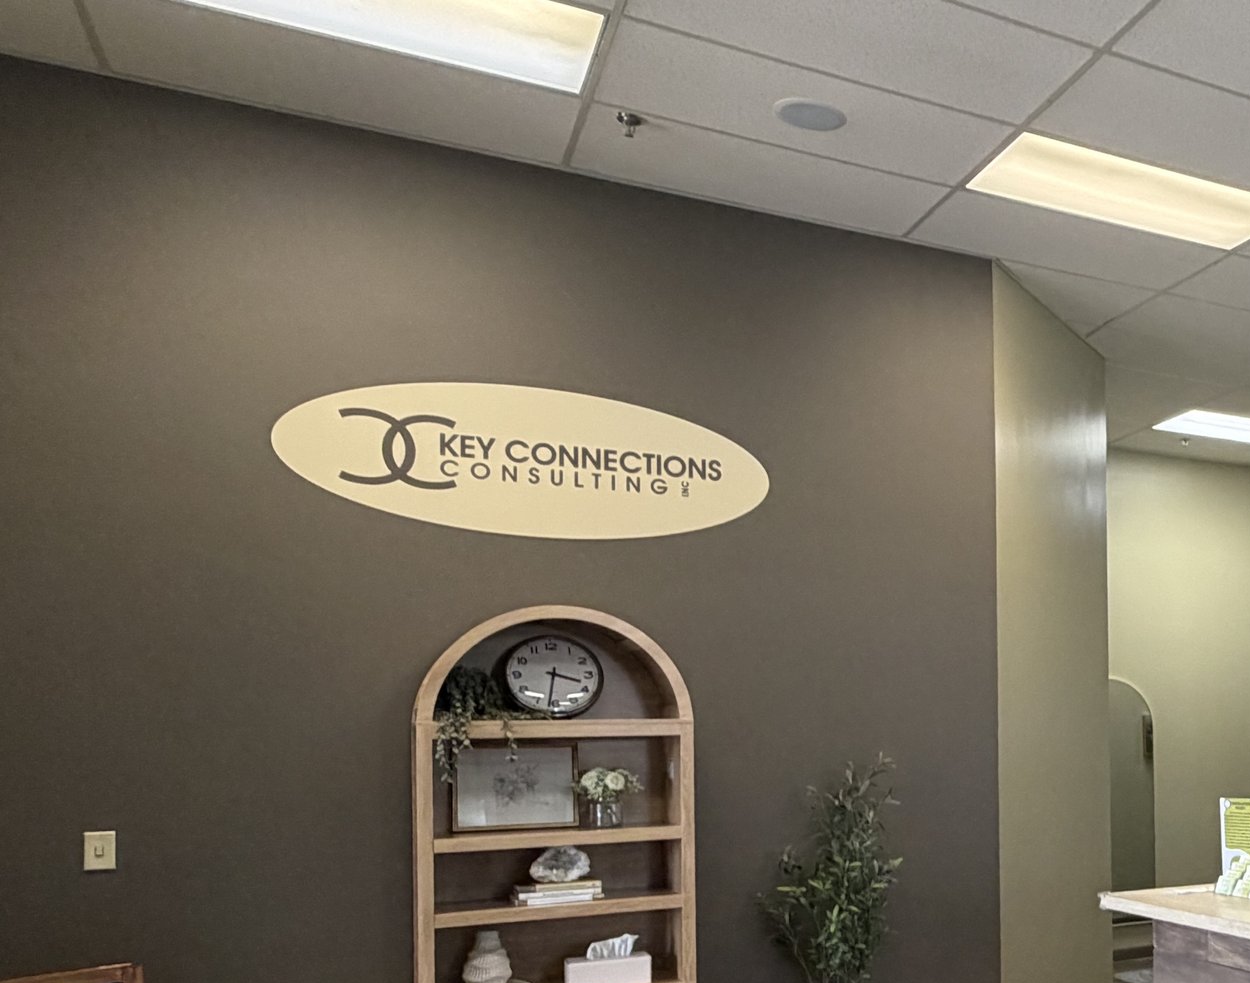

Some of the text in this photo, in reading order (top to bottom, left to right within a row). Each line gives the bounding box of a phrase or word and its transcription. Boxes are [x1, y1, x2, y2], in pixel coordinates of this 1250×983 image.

[439, 432, 722, 481] KEY CONNECTIONS
[439, 459, 669, 495] CONSULTING
[545, 642, 557, 651] 12
[517, 656, 528, 665] 10
[577, 657, 587, 665] 2
[583, 671, 593, 680] 3
